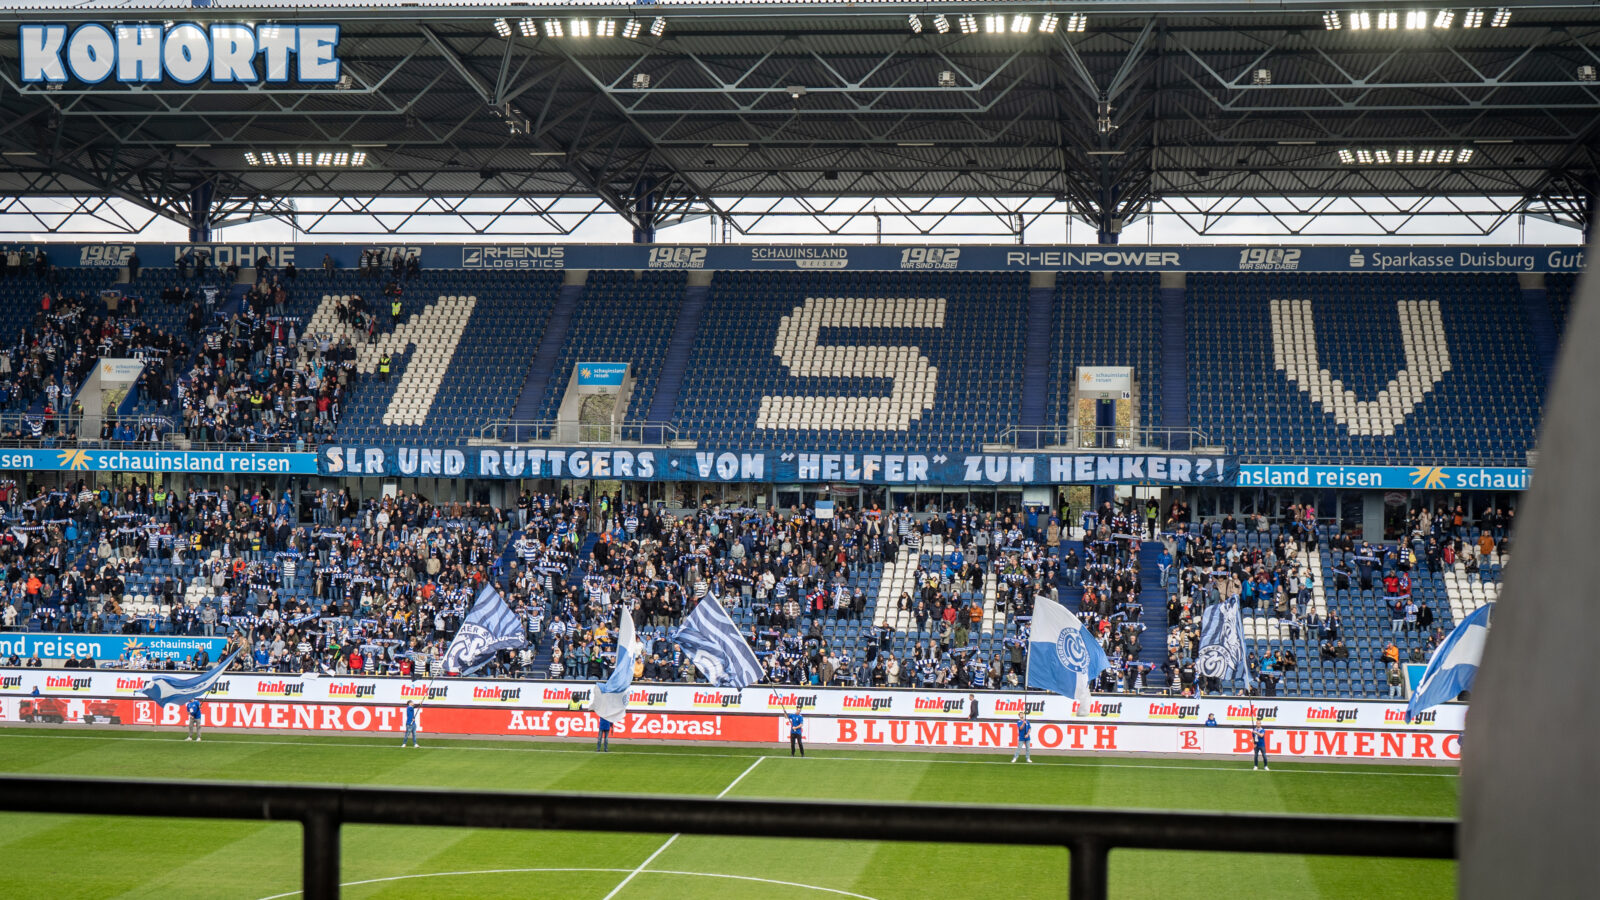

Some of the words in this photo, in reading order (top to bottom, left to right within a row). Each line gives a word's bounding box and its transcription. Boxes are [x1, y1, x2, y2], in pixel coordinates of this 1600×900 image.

[80, 246, 135, 261] 1902
[175, 246, 295, 267] KROHNE
[484, 247, 565, 258] RHENUS
[649, 247, 707, 262] 1902
[752, 248, 848, 258] SCHAUINSLAND
[901, 248, 961, 263] 1902
[1007, 252, 1181, 266] RHEINPOWER
[1240, 248, 1302, 264] 1902
[484, 259, 565, 268] LOGISTICS
[1372, 251, 1454, 270] Sparkasse
[1460, 251, 1535, 270] Duisburg
[1548, 251, 1587, 268] Gut.
[98, 452, 224, 470] schauinsland
[231, 454, 290, 472] reisen
[326, 446, 385, 474] SLR
[398, 447, 465, 475] UND
[480, 445, 655, 478] RÜTTGERS
[695, 451, 765, 480] VOM
[963, 455, 1035, 482] ZUM
[1050, 455, 1225, 482] HENKER?!
[1316, 467, 1382, 487] reisen
[33, 636, 101, 658] reisen
[150, 639, 212, 650] schauinsland
[150, 649, 180, 659] reisen
[46, 675, 92, 690] trinkgut
[258, 680, 305, 696] trinkgut
[329, 682, 376, 698] trinkgut
[401, 683, 449, 700] trinkgut
[473, 685, 521, 702] trinkgut
[694, 691, 742, 707] trinkgut
[768, 692, 817, 709] trinkgut
[843, 694, 893, 711] trinkgut
[915, 696, 964, 713] trinkgut
[995, 698, 1045, 715] trinkgut
[1149, 702, 1200, 719] trinkgut
[1227, 703, 1278, 721] trinkgut
[1306, 705, 1358, 723] trinkgut
[1385, 708, 1437, 725] tringut
[507, 709, 553, 731] Auf
[631, 714, 722, 735] Zebras!
